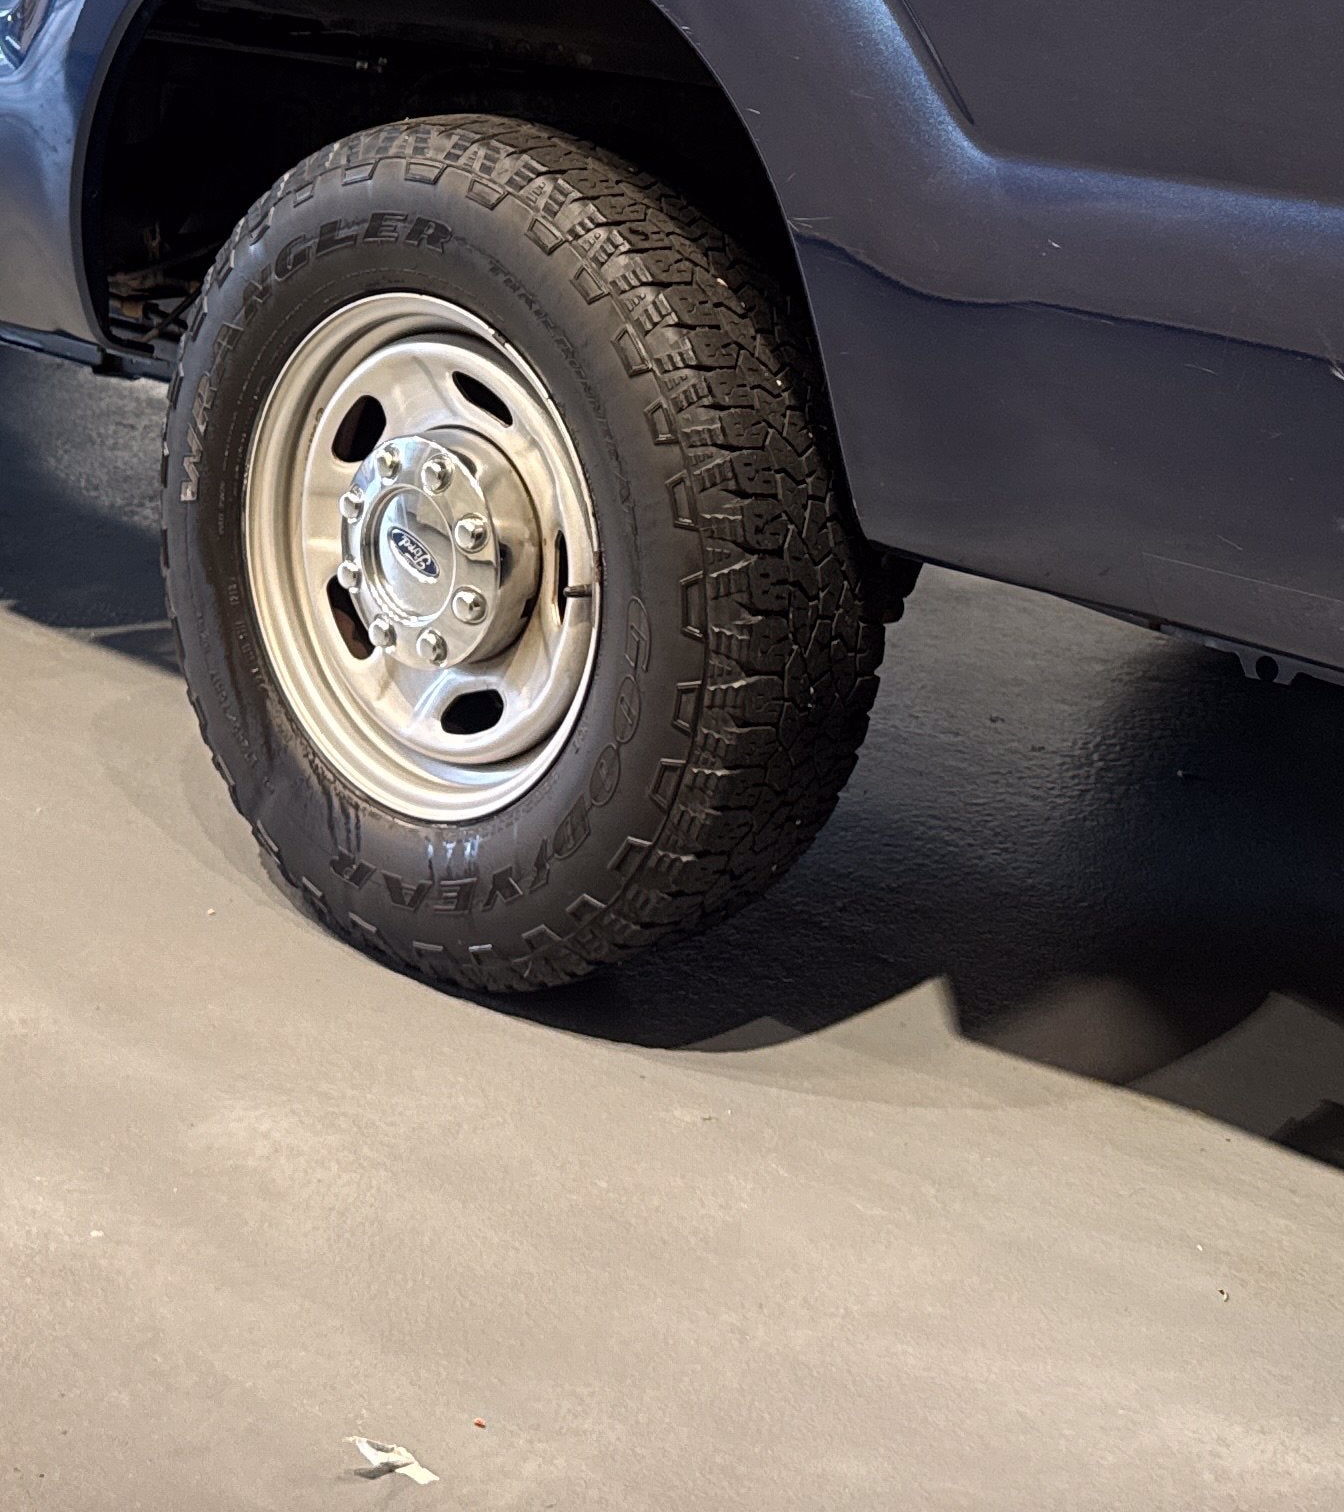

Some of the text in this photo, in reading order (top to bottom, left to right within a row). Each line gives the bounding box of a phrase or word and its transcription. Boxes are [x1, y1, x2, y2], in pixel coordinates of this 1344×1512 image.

[180, 211, 454, 502] WRANGLER
[397, 534, 433, 571] Ford
[328, 595, 652, 914] GOODYEAR
